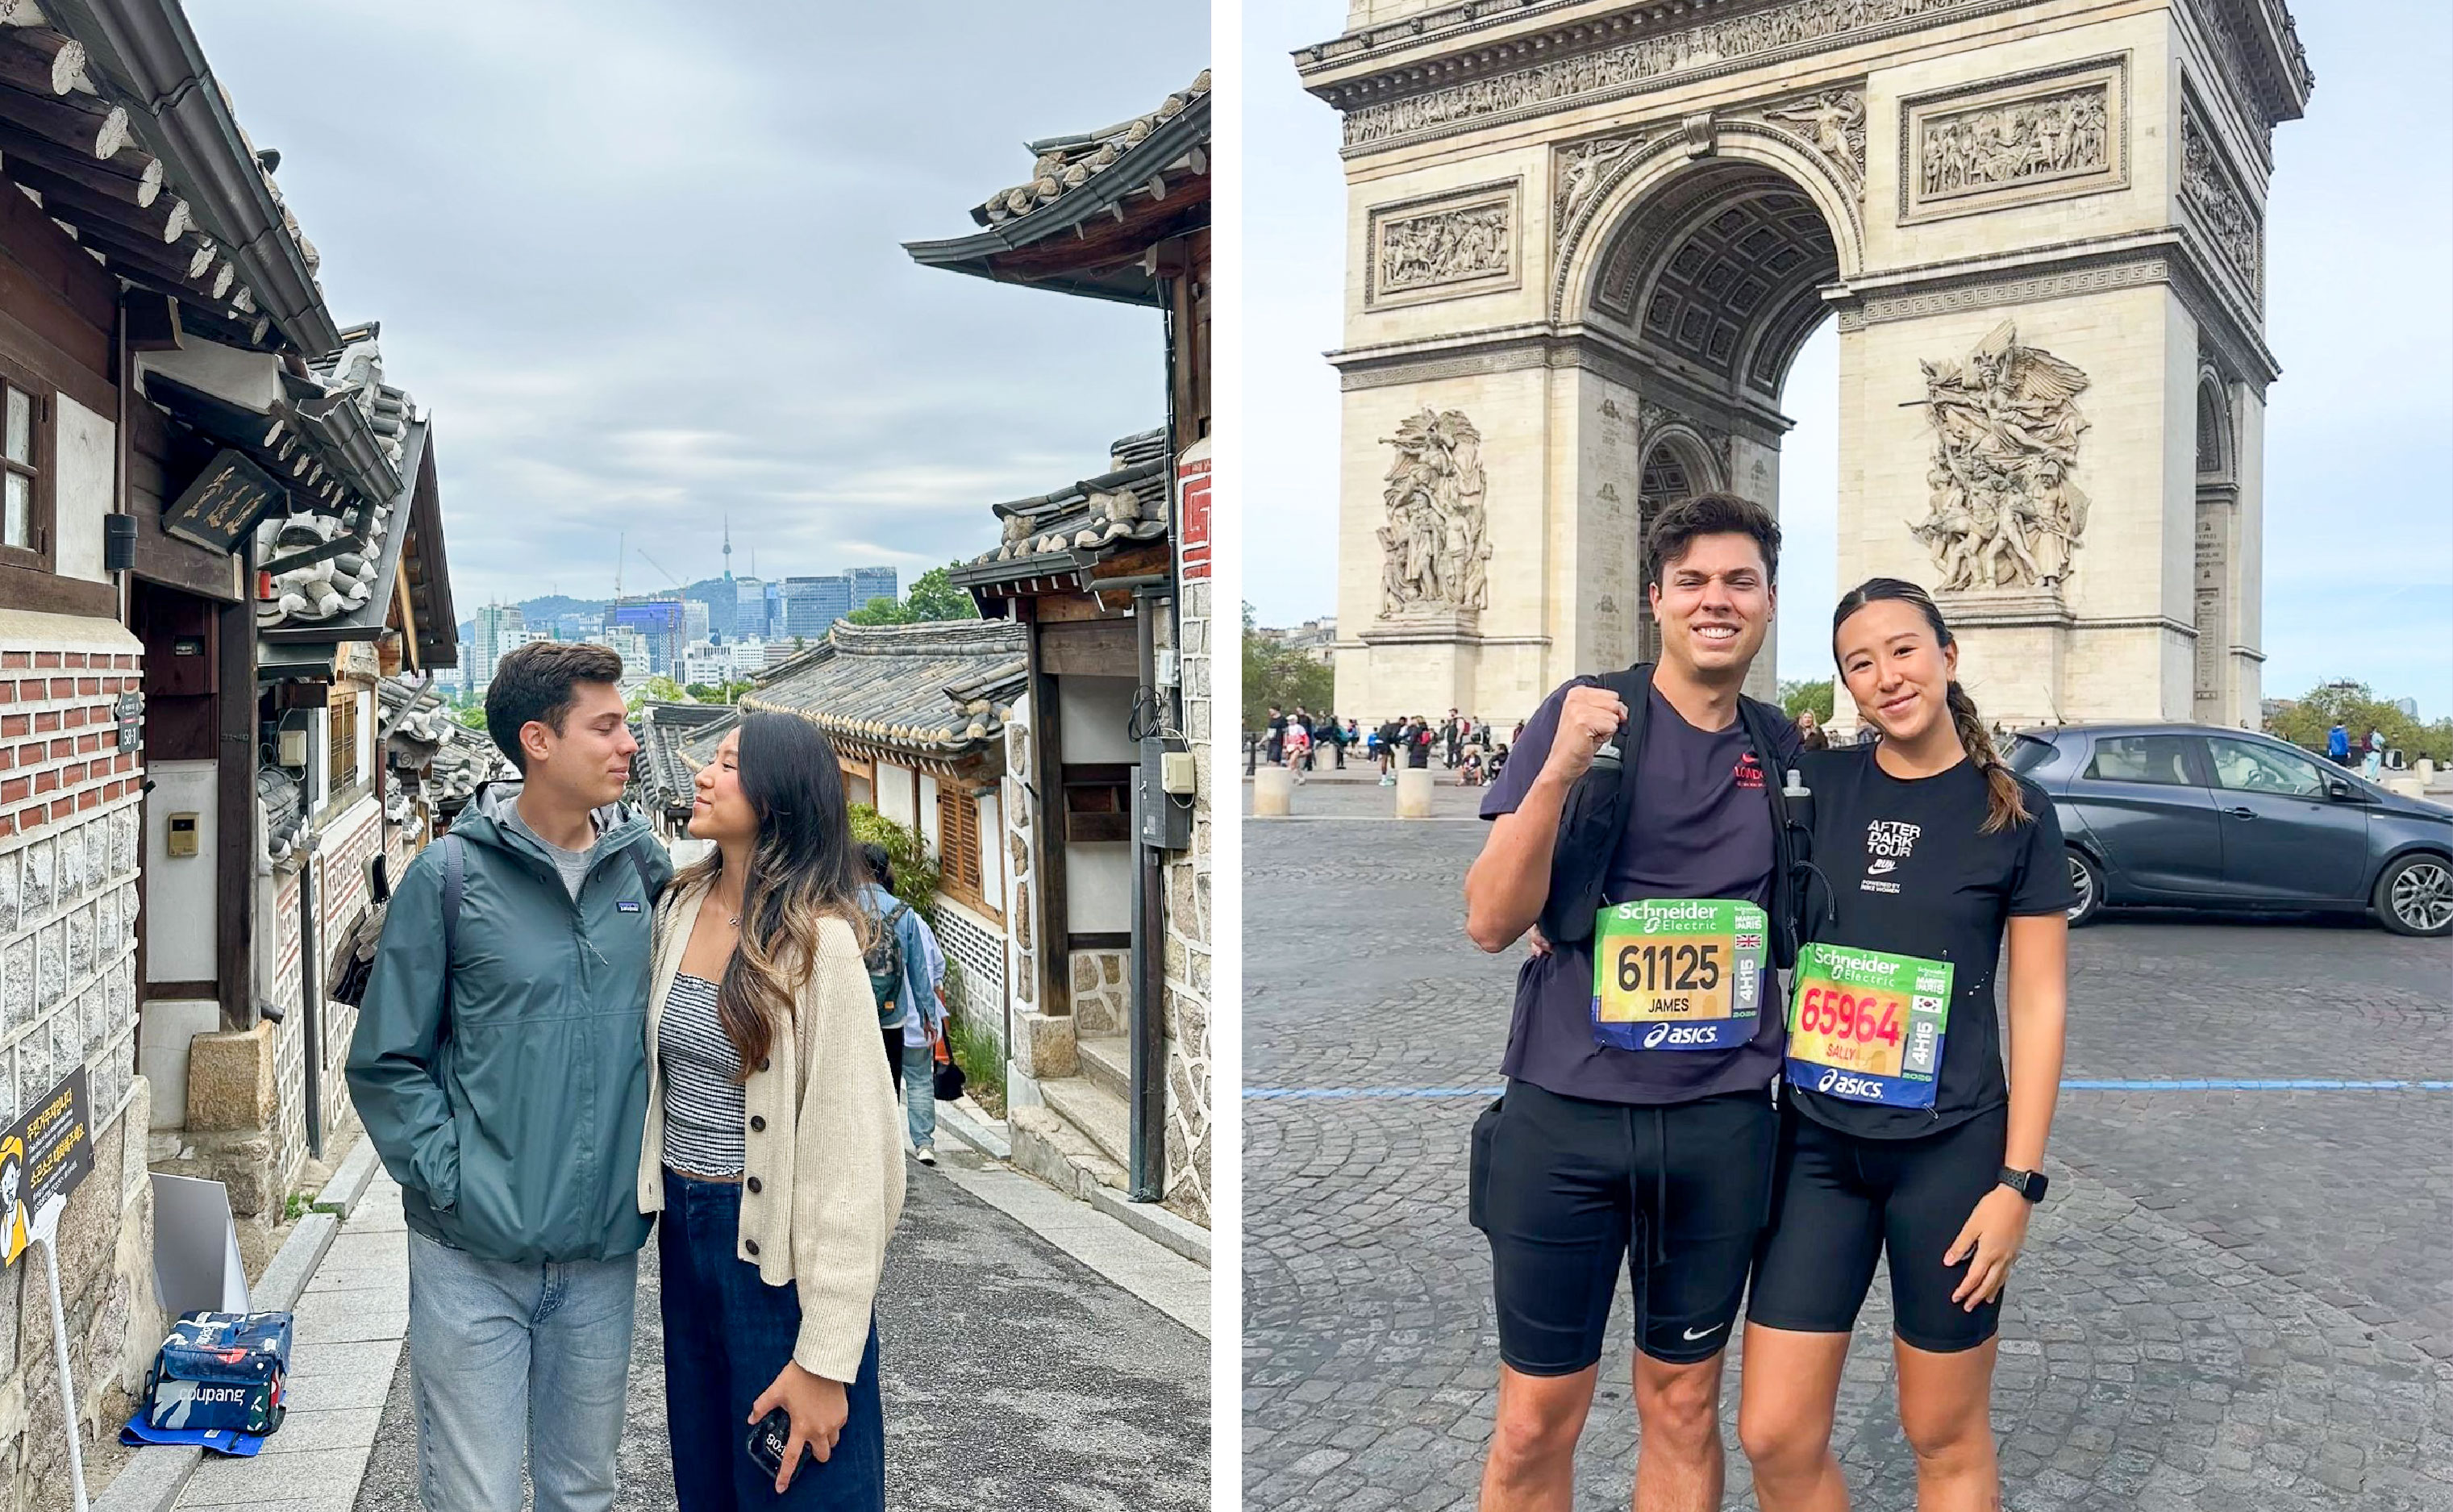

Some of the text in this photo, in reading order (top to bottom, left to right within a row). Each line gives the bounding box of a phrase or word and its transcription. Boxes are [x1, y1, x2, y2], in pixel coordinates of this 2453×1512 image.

[124, 727, 136, 746] 58-1
[1867, 819, 1922, 838] AFTER
[1867, 841, 1912, 857] TOUR
[1868, 831, 1915, 848] DARK
[1618, 902, 1718, 920] Schneider
[1663, 919, 1718, 931] Electric
[1618, 944, 1719, 992] 61125
[1814, 947, 1901, 975] Schneider
[1740, 958, 1755, 1002] 4H15
[1844, 969, 1895, 988] Electric
[1648, 998, 1689, 1013] JAMES
[1801, 988, 1900, 1048] 65964
[1826, 1043, 1856, 1061] SALLY
[1912, 1021, 1934, 1065] 4H15
[179, 1388, 246, 1406] coupang
